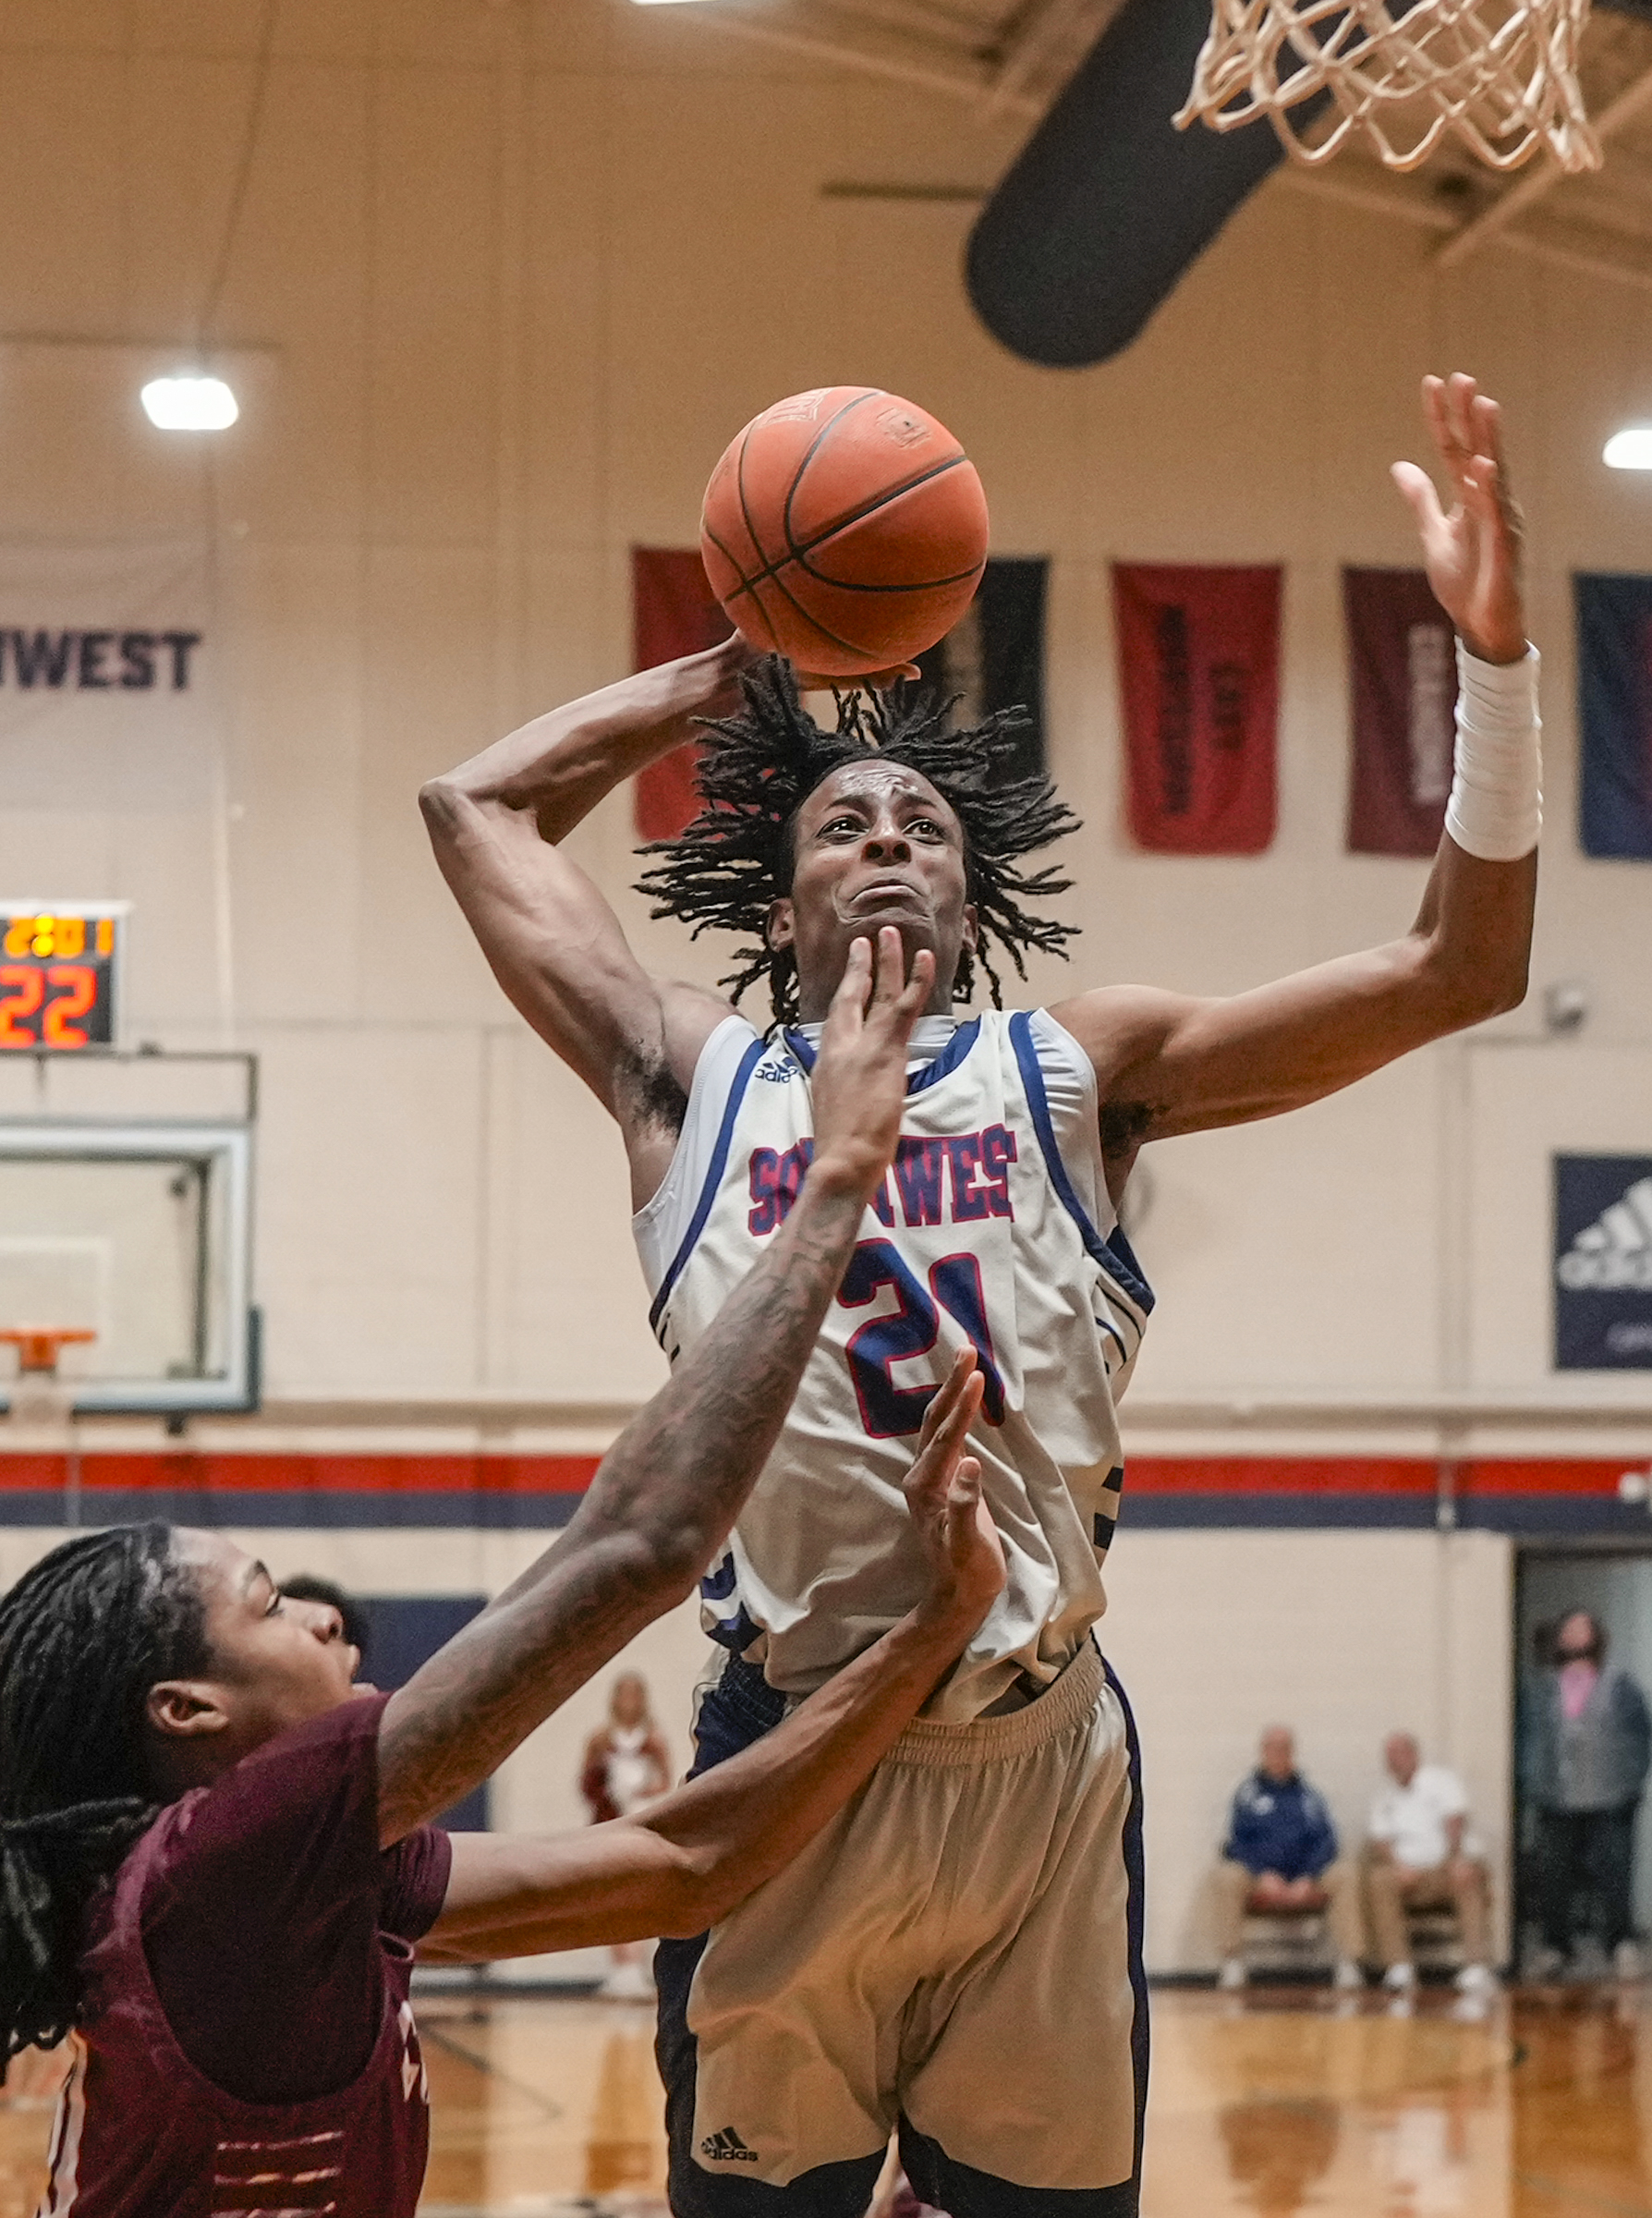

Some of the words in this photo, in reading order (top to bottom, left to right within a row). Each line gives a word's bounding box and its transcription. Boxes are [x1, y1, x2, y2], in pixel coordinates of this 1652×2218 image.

[0, 628, 200, 689] WEST
[0, 965, 97, 1049] 22
[838, 1237, 1006, 1439] 21
